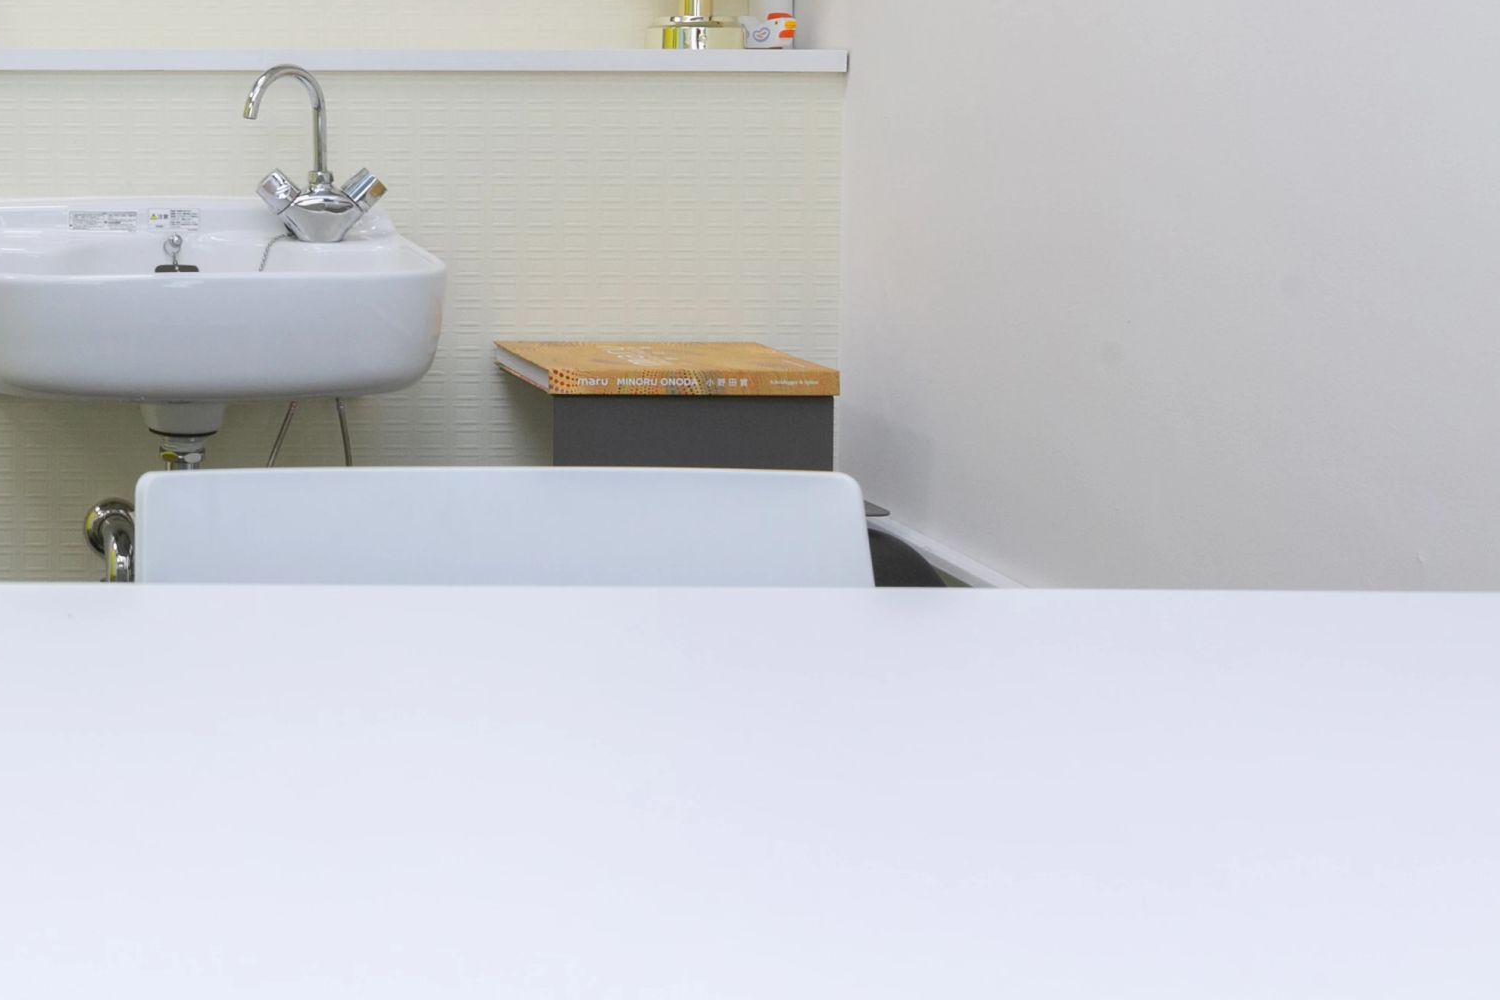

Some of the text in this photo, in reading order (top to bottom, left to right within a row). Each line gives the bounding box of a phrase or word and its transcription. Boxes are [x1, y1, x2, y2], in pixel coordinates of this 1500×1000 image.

[577, 377, 699, 387] maru MINORU ONODA
